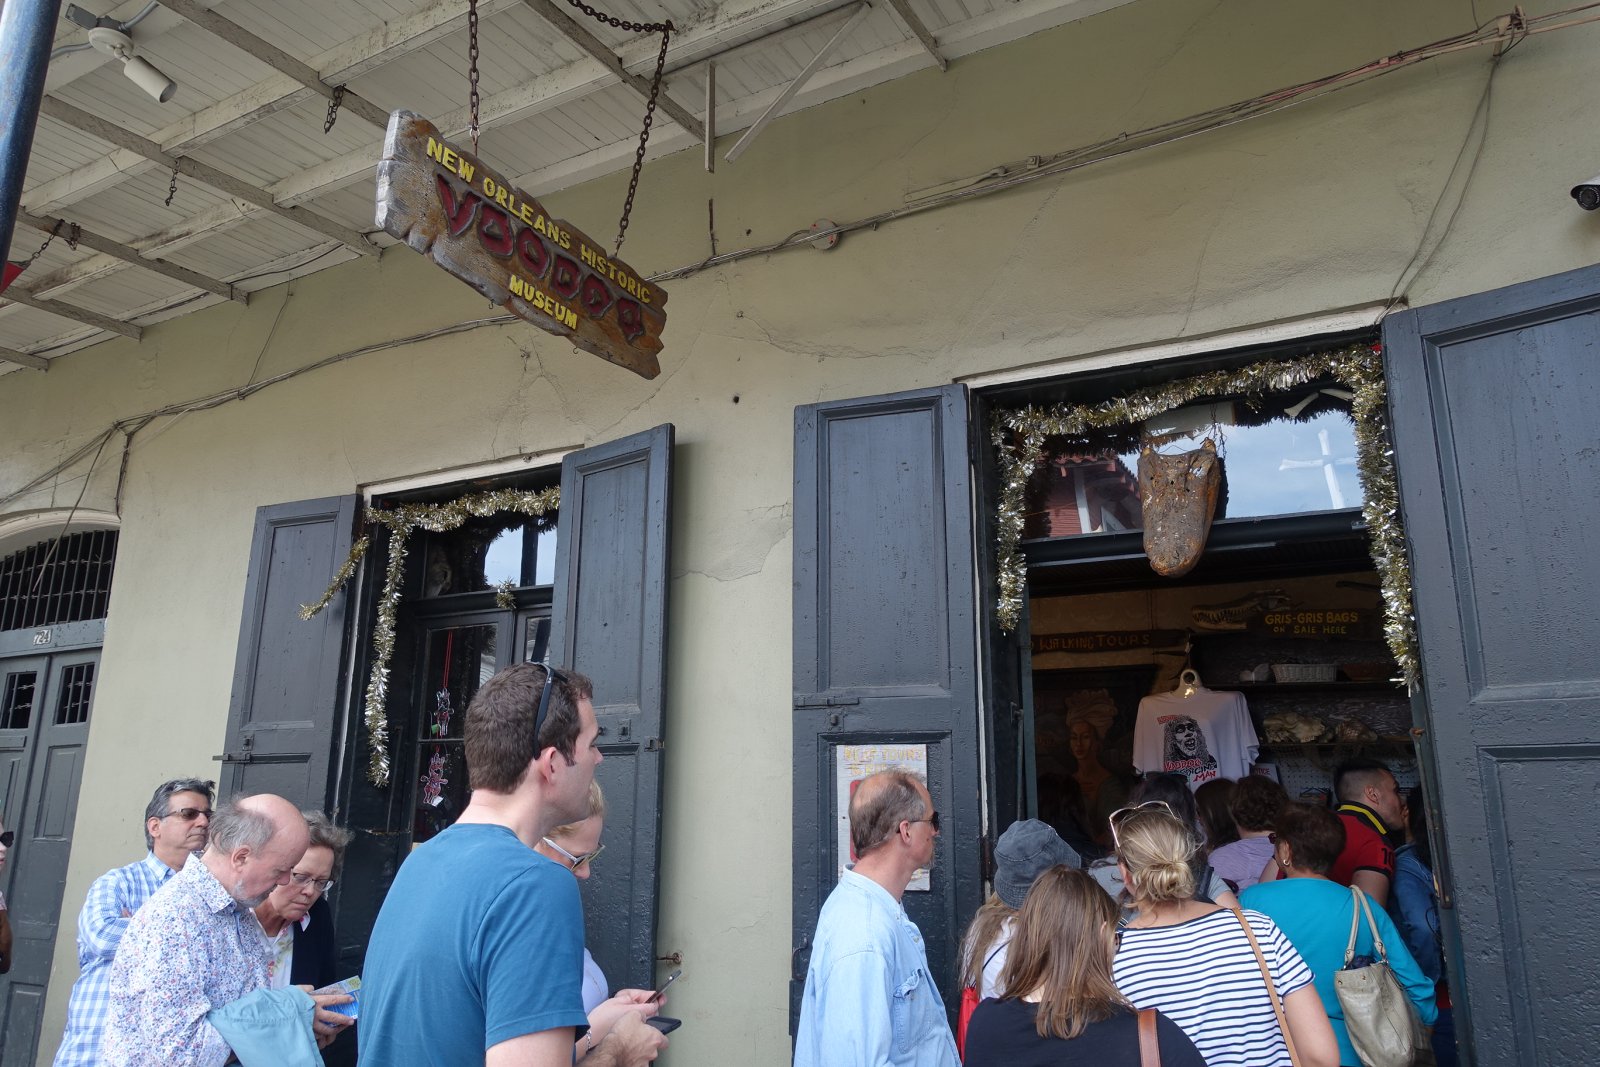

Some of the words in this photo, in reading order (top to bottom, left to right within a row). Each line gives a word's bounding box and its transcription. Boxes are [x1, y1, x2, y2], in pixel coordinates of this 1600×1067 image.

[427, 137, 476, 183] NEW
[483, 177, 571, 250] ORLEANS
[581, 244, 650, 304] HISTORIC
[434, 172, 645, 342] VOODOO
[509, 275, 577, 330] MUSEUM
[1264, 612, 1323, 625] GRIS-GRIS
[1326, 611, 1359, 624] BAGS
[1323, 625, 1347, 634] HERE
[1095, 633, 1150, 648] TOURS
[1193, 770, 1216, 782] MAN
